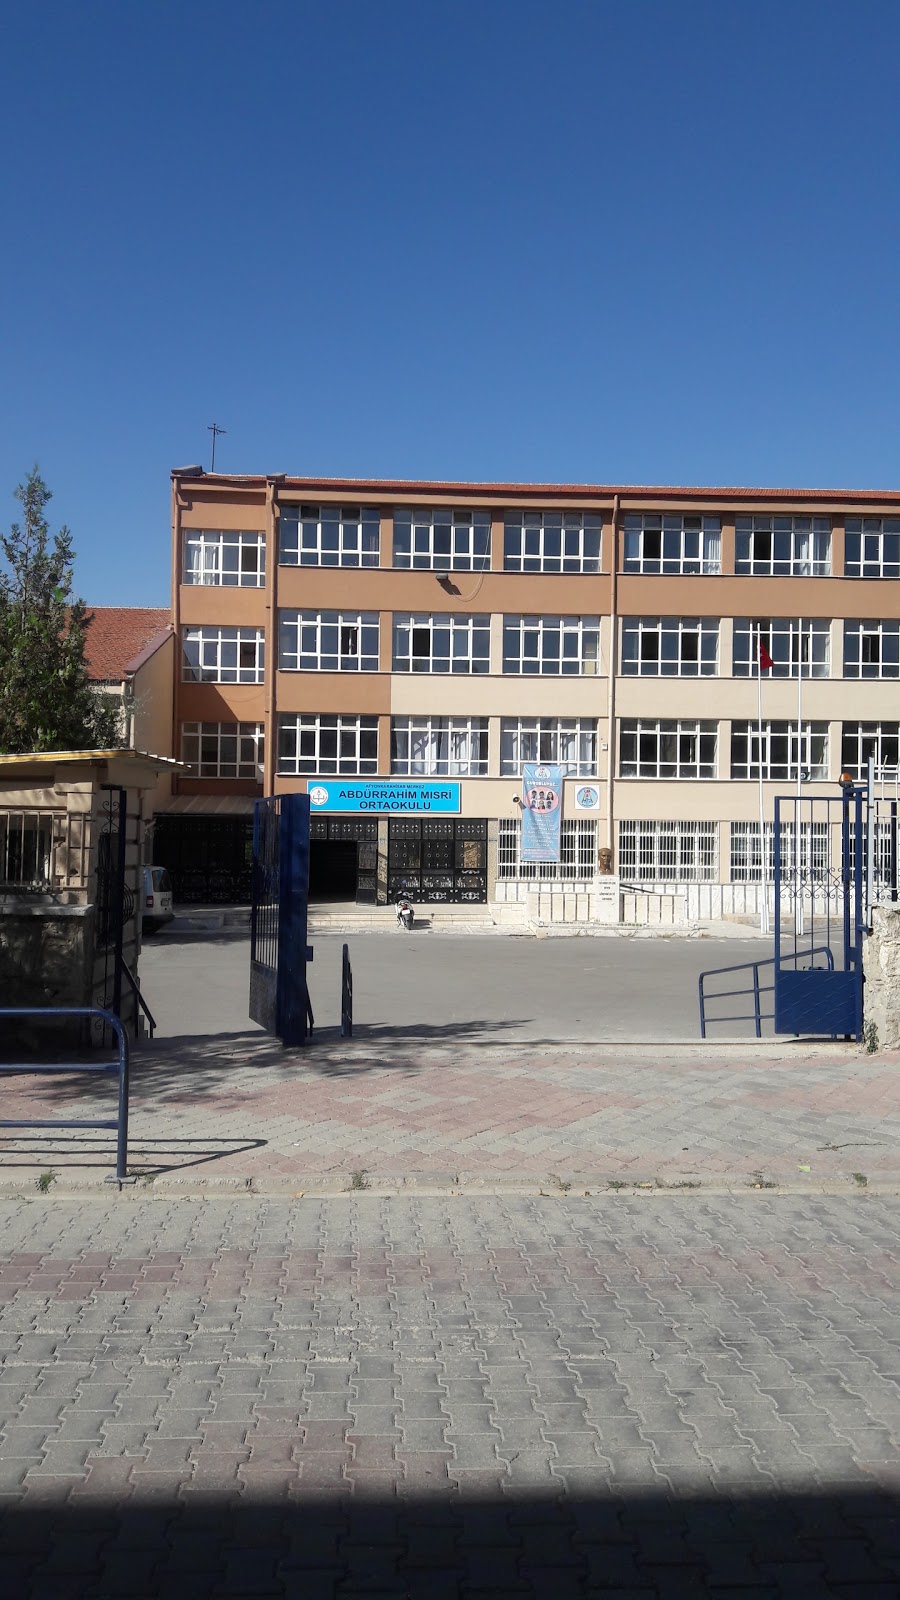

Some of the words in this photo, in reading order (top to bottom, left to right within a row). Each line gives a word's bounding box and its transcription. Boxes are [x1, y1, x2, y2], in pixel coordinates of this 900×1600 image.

[338, 788, 416, 798] ABDÜRRAHİM
[420, 790, 452, 800] MISRİ
[359, 801, 431, 810] ORTAOKULU
